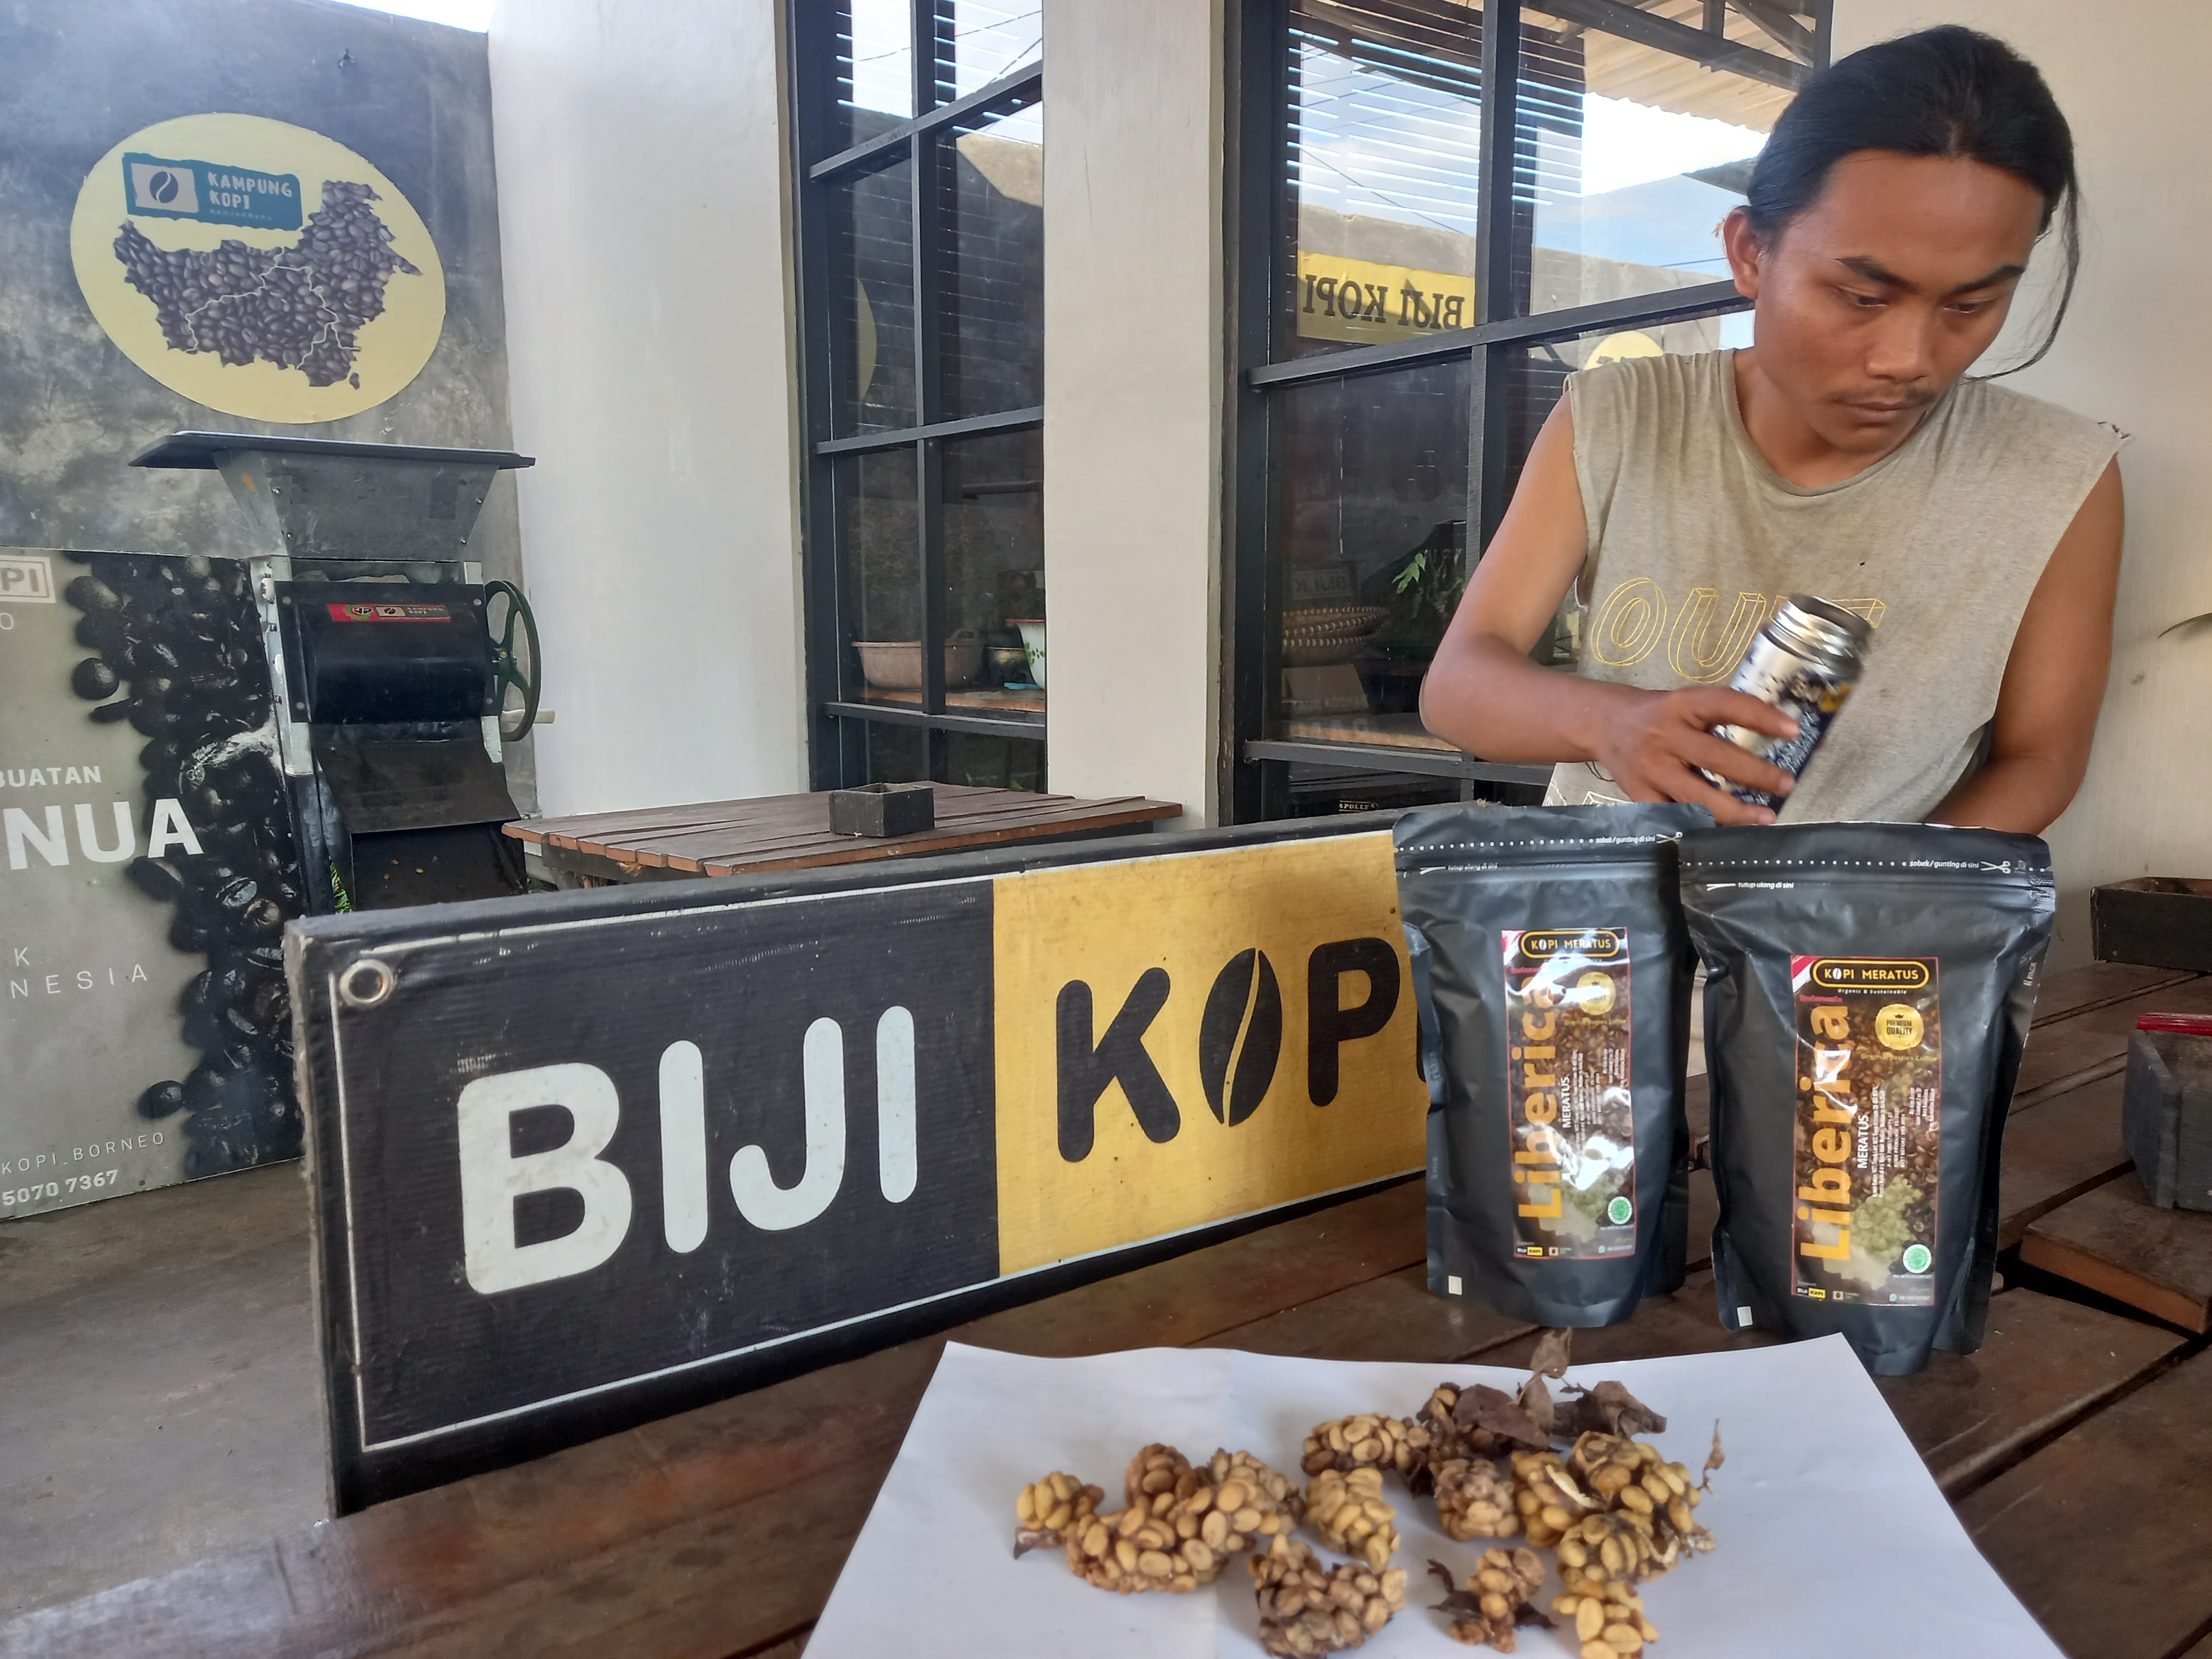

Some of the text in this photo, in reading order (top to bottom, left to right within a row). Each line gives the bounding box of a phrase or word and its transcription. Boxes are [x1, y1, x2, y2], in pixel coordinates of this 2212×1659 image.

[208, 171, 292, 197] KAMPUNG
[209, 190, 250, 209] KOPI
[2, 798, 205, 870] NUA
[1531, 938, 1611, 950] KOPI MERATUS
[10, 964, 148, 999] NESIA
[1825, 968, 1919, 980] KOPI MERATUS
[1886, 1027, 1913, 1035] QUALITY
[457, 937, 1428, 1294] BIJI KOP
[1561, 1076, 1572, 1129] MERATUS
[1857, 1114, 1869, 1168] MERATUS
[2, 1169, 119, 1206] 5070 7367
